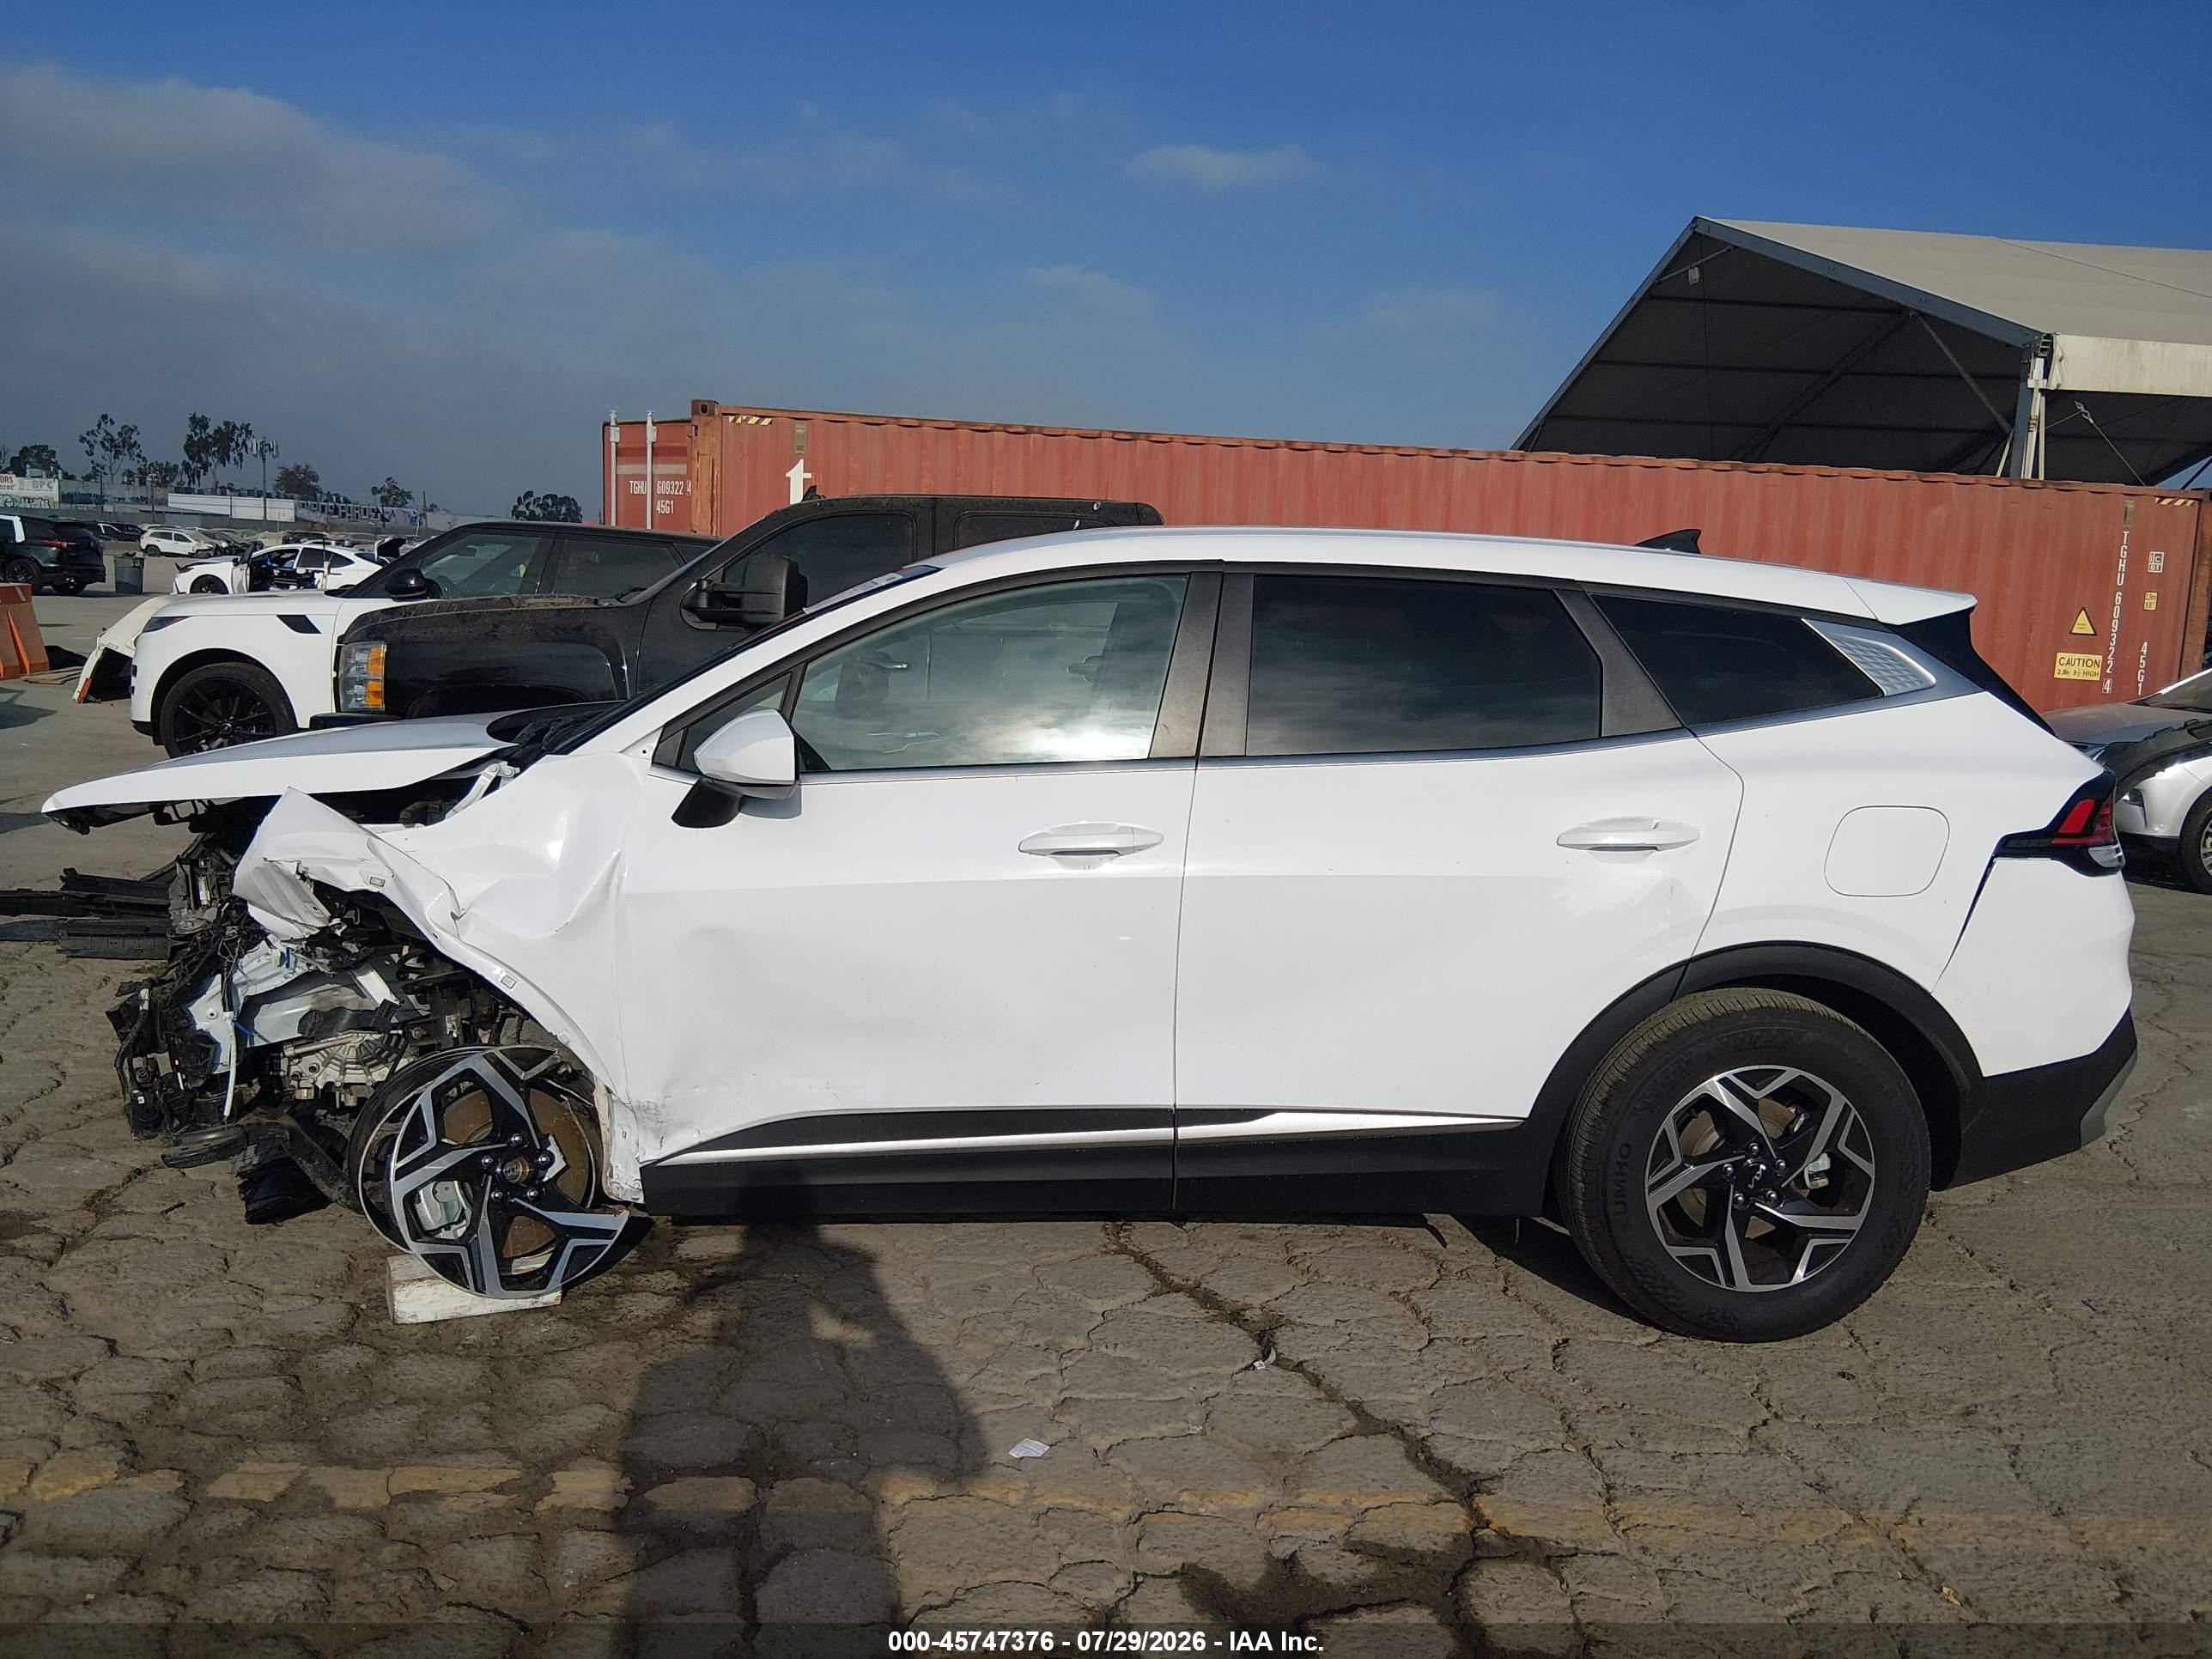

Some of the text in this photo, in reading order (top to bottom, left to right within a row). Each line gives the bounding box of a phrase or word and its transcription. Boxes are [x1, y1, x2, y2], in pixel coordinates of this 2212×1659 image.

[629, 480, 647, 495] TGHU
[656, 480, 684, 495] 609322
[656, 499, 674, 514] 45G1
[2104, 531, 2130, 693] TGHU 609322 4
[2058, 656, 2101, 669] CAUTION
[2137, 641, 2148, 696] 45G1
[1613, 1142, 1632, 1226] UMHO
